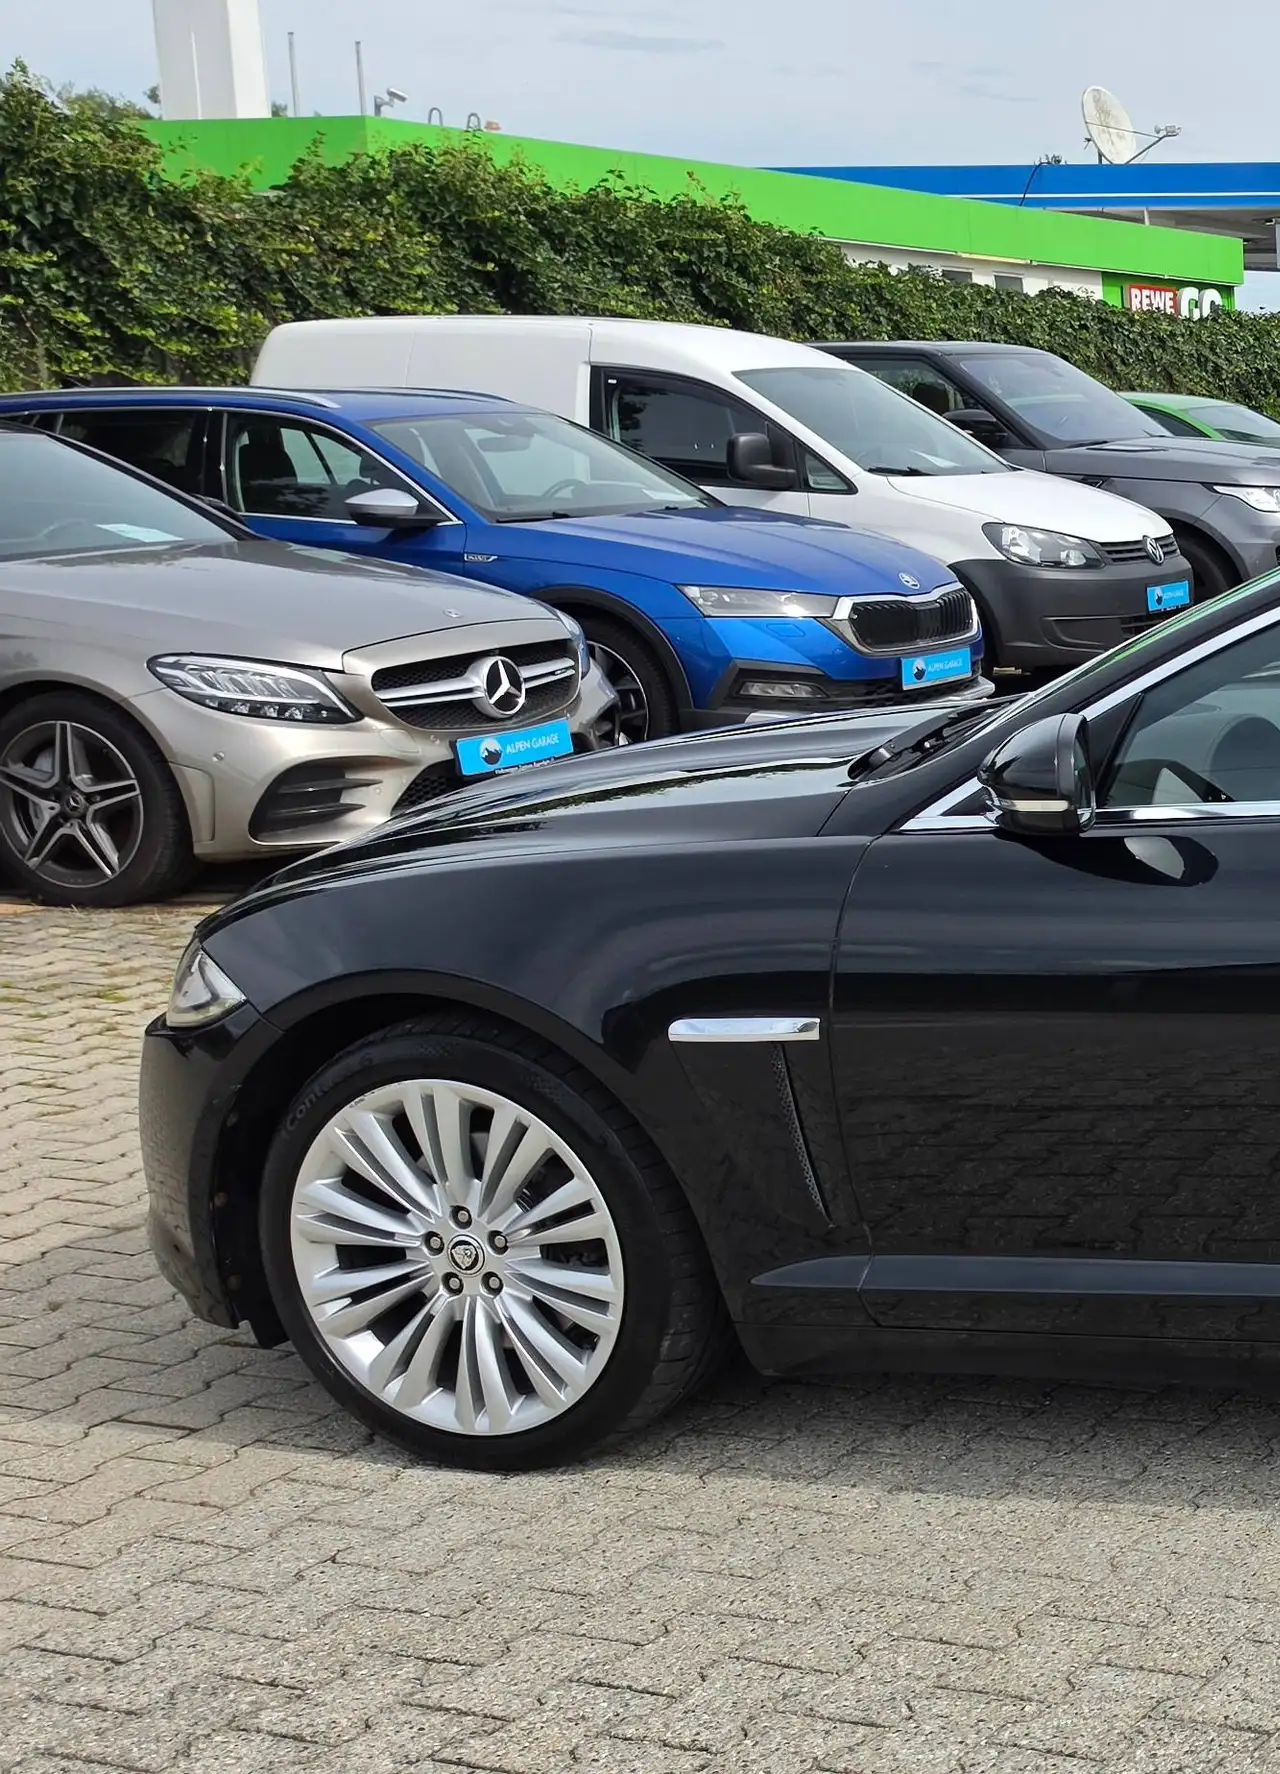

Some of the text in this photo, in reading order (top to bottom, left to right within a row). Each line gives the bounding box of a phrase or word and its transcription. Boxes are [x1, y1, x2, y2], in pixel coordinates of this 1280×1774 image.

[1130, 286, 1223, 321] REWE GO
[506, 733, 560, 754] ALPEN GARAGE
